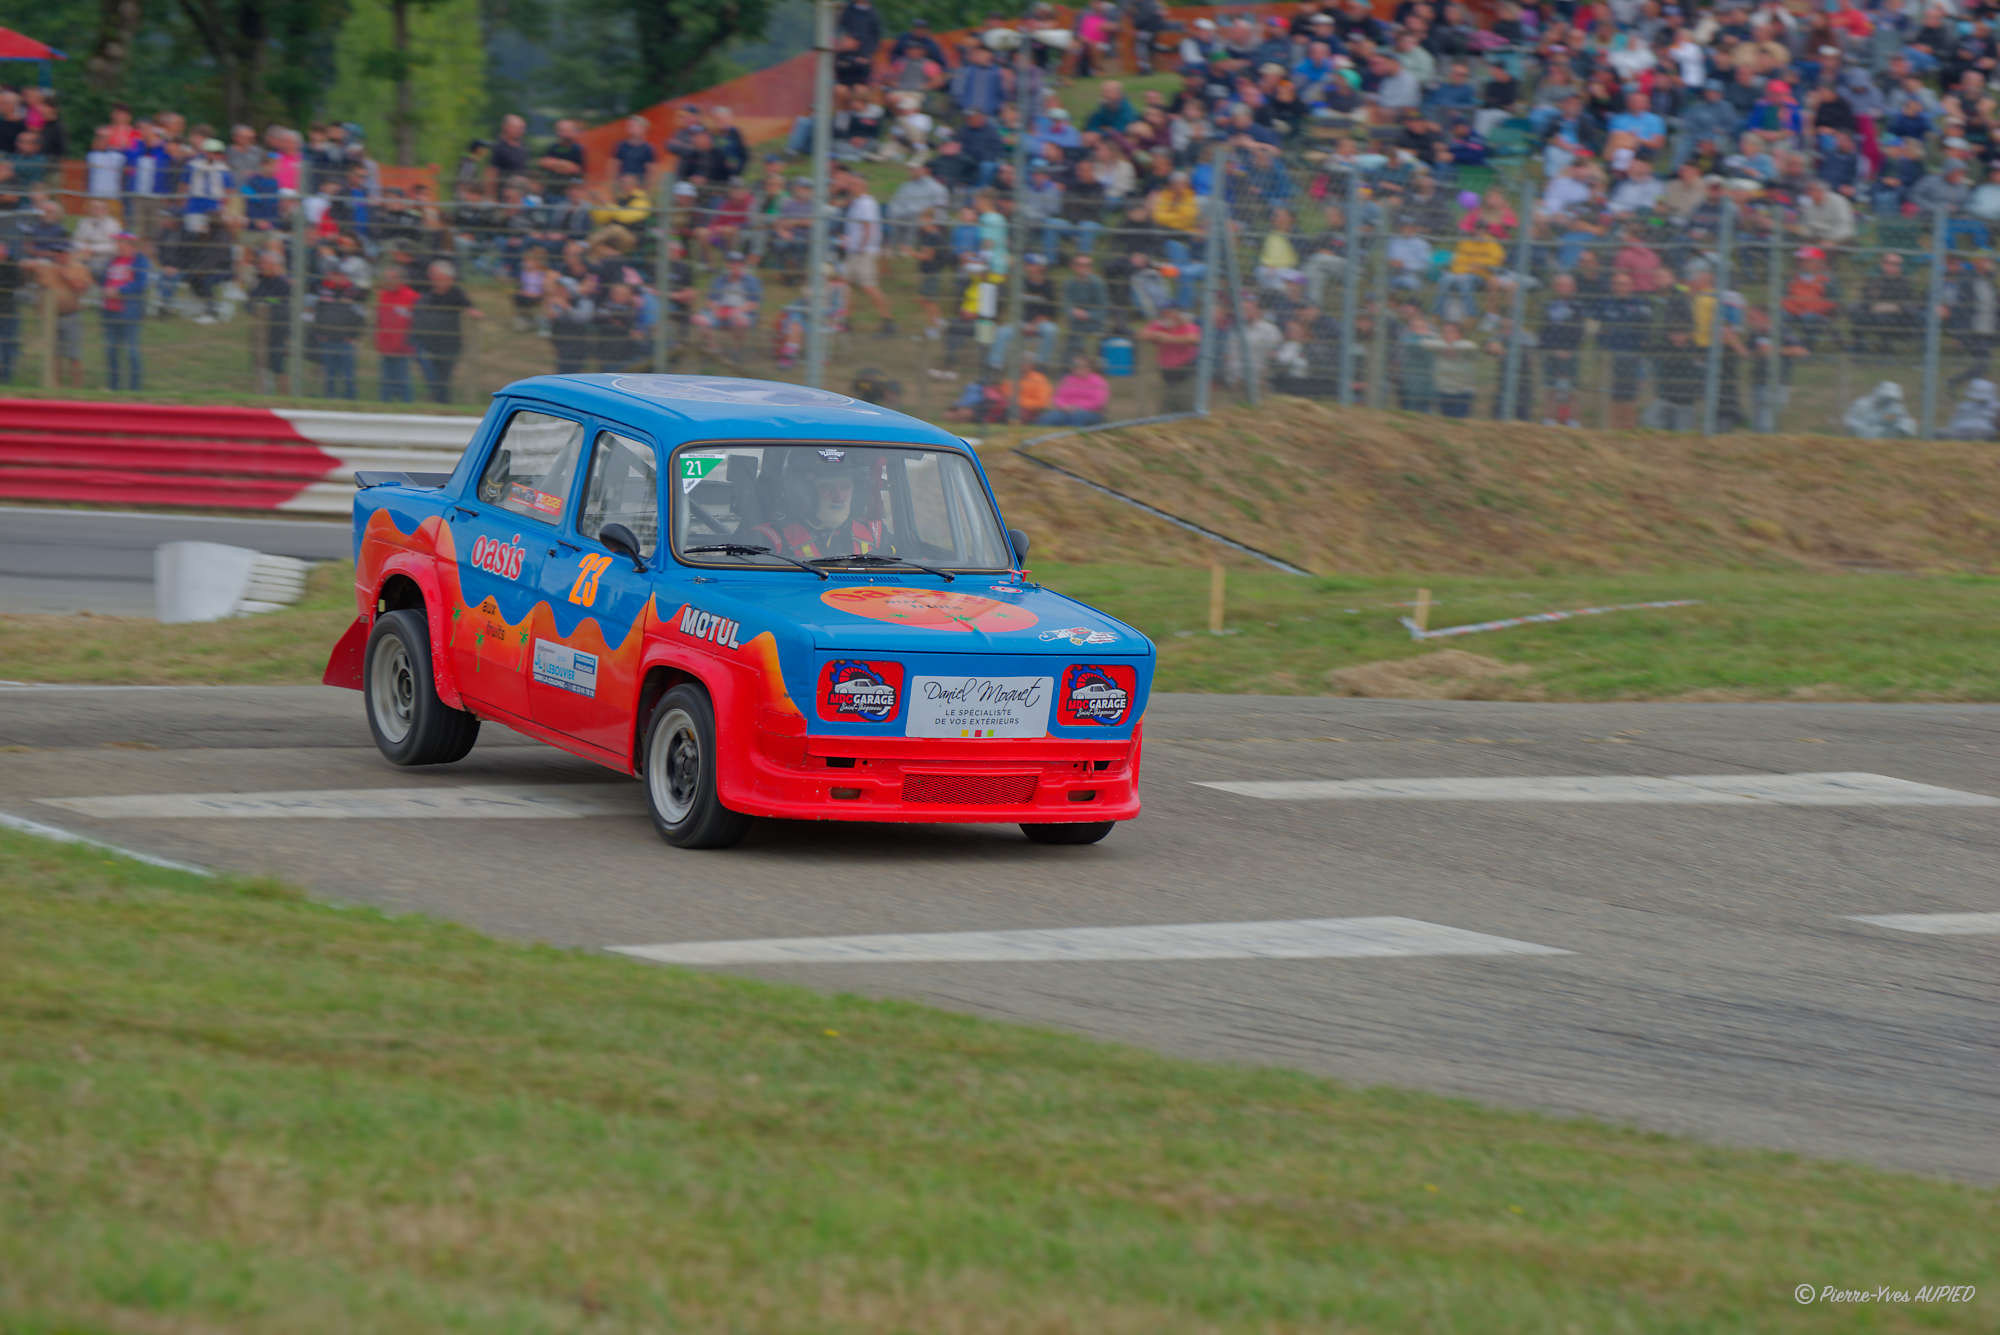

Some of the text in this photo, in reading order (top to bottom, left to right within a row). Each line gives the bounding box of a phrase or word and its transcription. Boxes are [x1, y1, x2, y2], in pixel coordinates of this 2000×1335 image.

[686, 460, 702, 476] 21
[471, 534, 526, 581] oasis
[568, 552, 613, 608] 23
[679, 605, 740, 651] MOTUL
[923, 677, 1043, 711] Daniel Moquet
[934, 718, 945, 726] DE
[950, 718, 967, 726] VOS
[945, 709, 956, 717] LE
